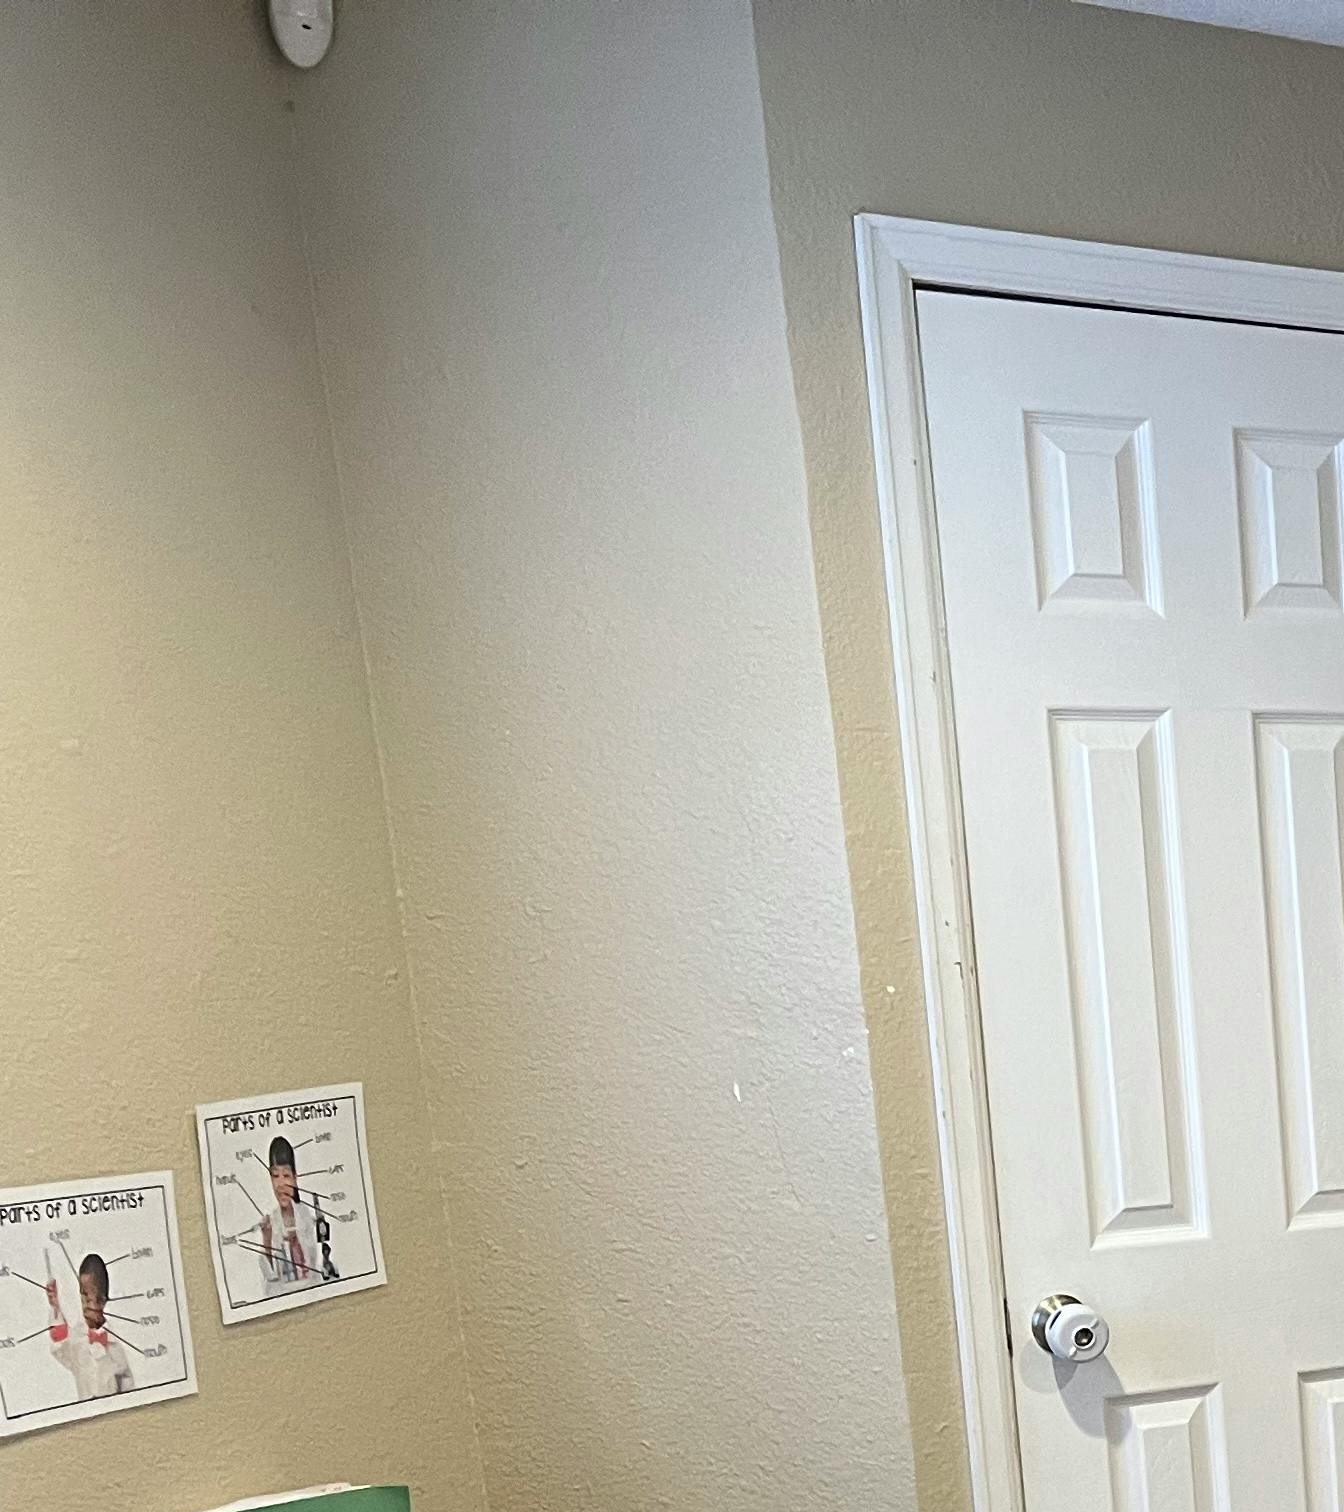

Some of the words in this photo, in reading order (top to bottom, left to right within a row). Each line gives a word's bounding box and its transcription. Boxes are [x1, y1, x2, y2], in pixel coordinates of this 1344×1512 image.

[222, 1115, 254, 1135] Parts
[258, 1112, 271, 1128] of
[276, 1110, 284, 1124] a
[46, 1202, 62, 1220] of
[68, 1199, 77, 1216] a
